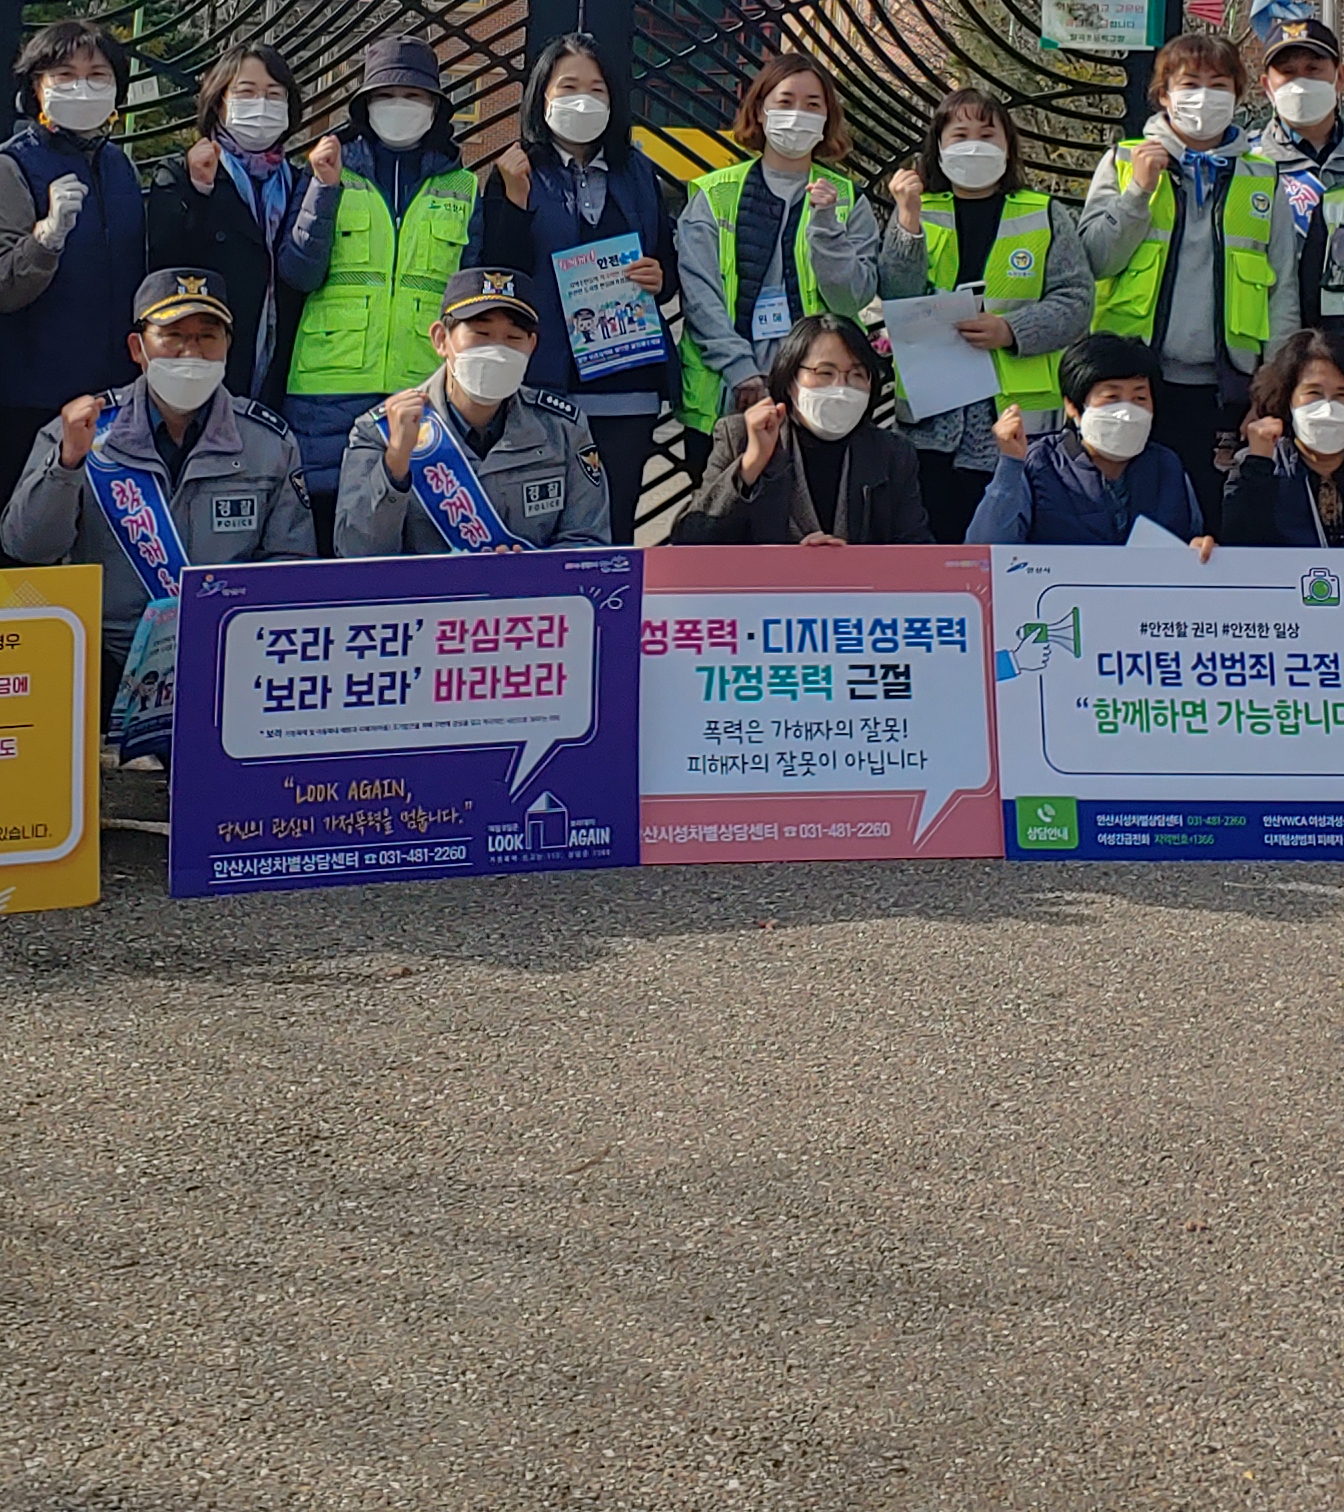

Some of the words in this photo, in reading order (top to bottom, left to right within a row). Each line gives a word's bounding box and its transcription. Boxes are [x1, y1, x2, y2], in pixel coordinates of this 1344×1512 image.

[435, 614, 570, 656] 관심주라
[1140, 621, 1189, 638] #안전할
[1191, 621, 1219, 638] 권리
[1222, 622, 1270, 639] #안전한
[1273, 622, 1300, 639] 일상
[432, 662, 568, 705] 바라보라
[695, 664, 834, 702] 가정폭력
[846, 664, 913, 700] 근절
[1096, 651, 1182, 686] 디지털
[1191, 652, 1277, 687] 성범죄
[1283, 652, 1342, 688] 근절
[702, 719, 765, 746] 폭력은
[770, 719, 854, 742] 가해자의
[860, 716, 909, 744] 잘못!
[687, 753, 769, 776] 피해자의
[775, 750, 837, 778] 잘못이
[845, 749, 928, 775] 아닙니다
[217, 819, 264, 843] 당신의
[272, 817, 315, 838] 관심이
[323, 813, 394, 837] 가정폭력을
[488, 833, 524, 852] LOOK
[568, 827, 611, 847] AGAIN
[1026, 826, 1069, 841] 상담안내
[212, 851, 359, 879] 안산시성차별상담센터
